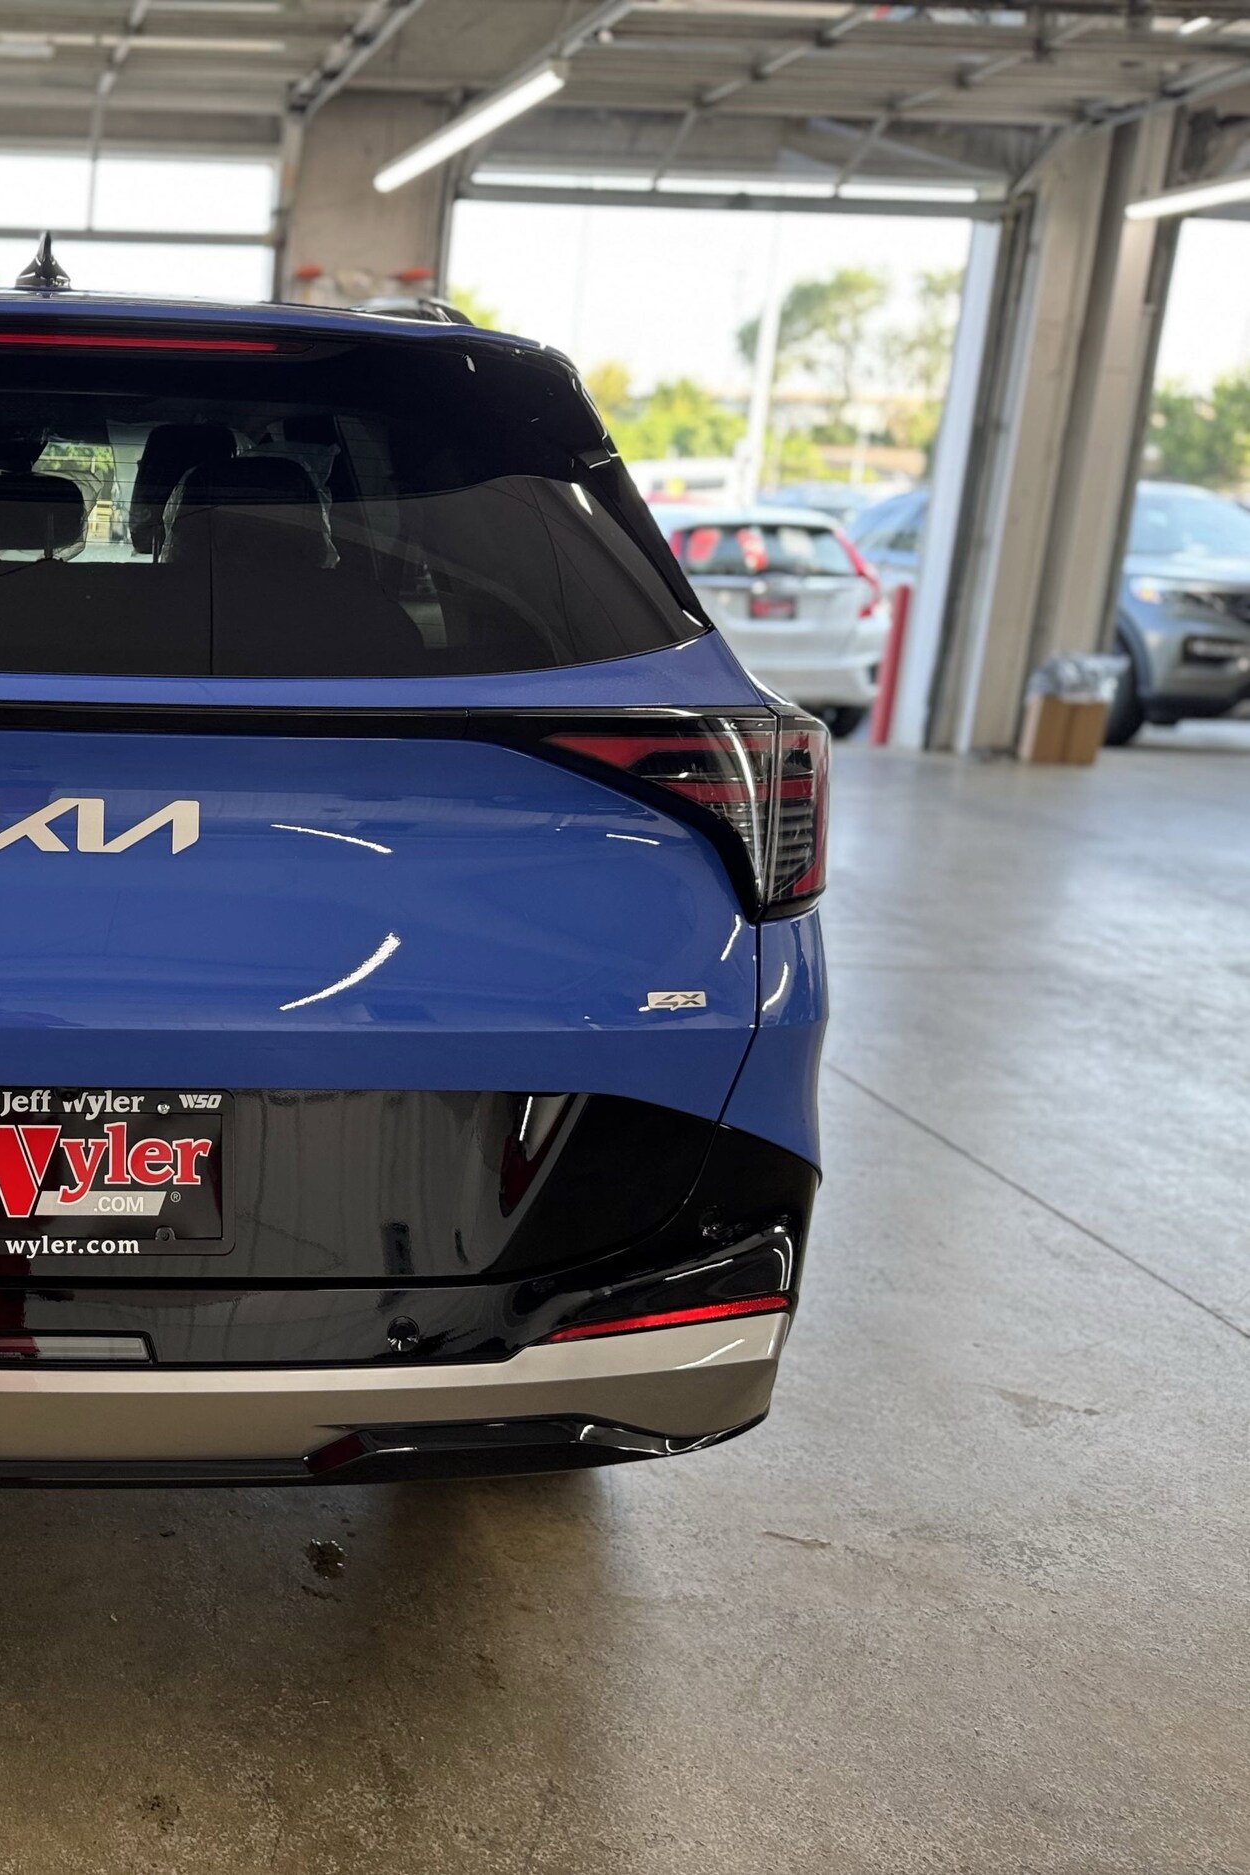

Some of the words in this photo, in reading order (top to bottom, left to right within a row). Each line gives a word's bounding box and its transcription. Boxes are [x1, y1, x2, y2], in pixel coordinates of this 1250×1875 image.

[0, 1090, 51, 1117] Jeff
[92, 1196, 145, 1213] .COM
[5, 1236, 140, 1259] wyler.com
